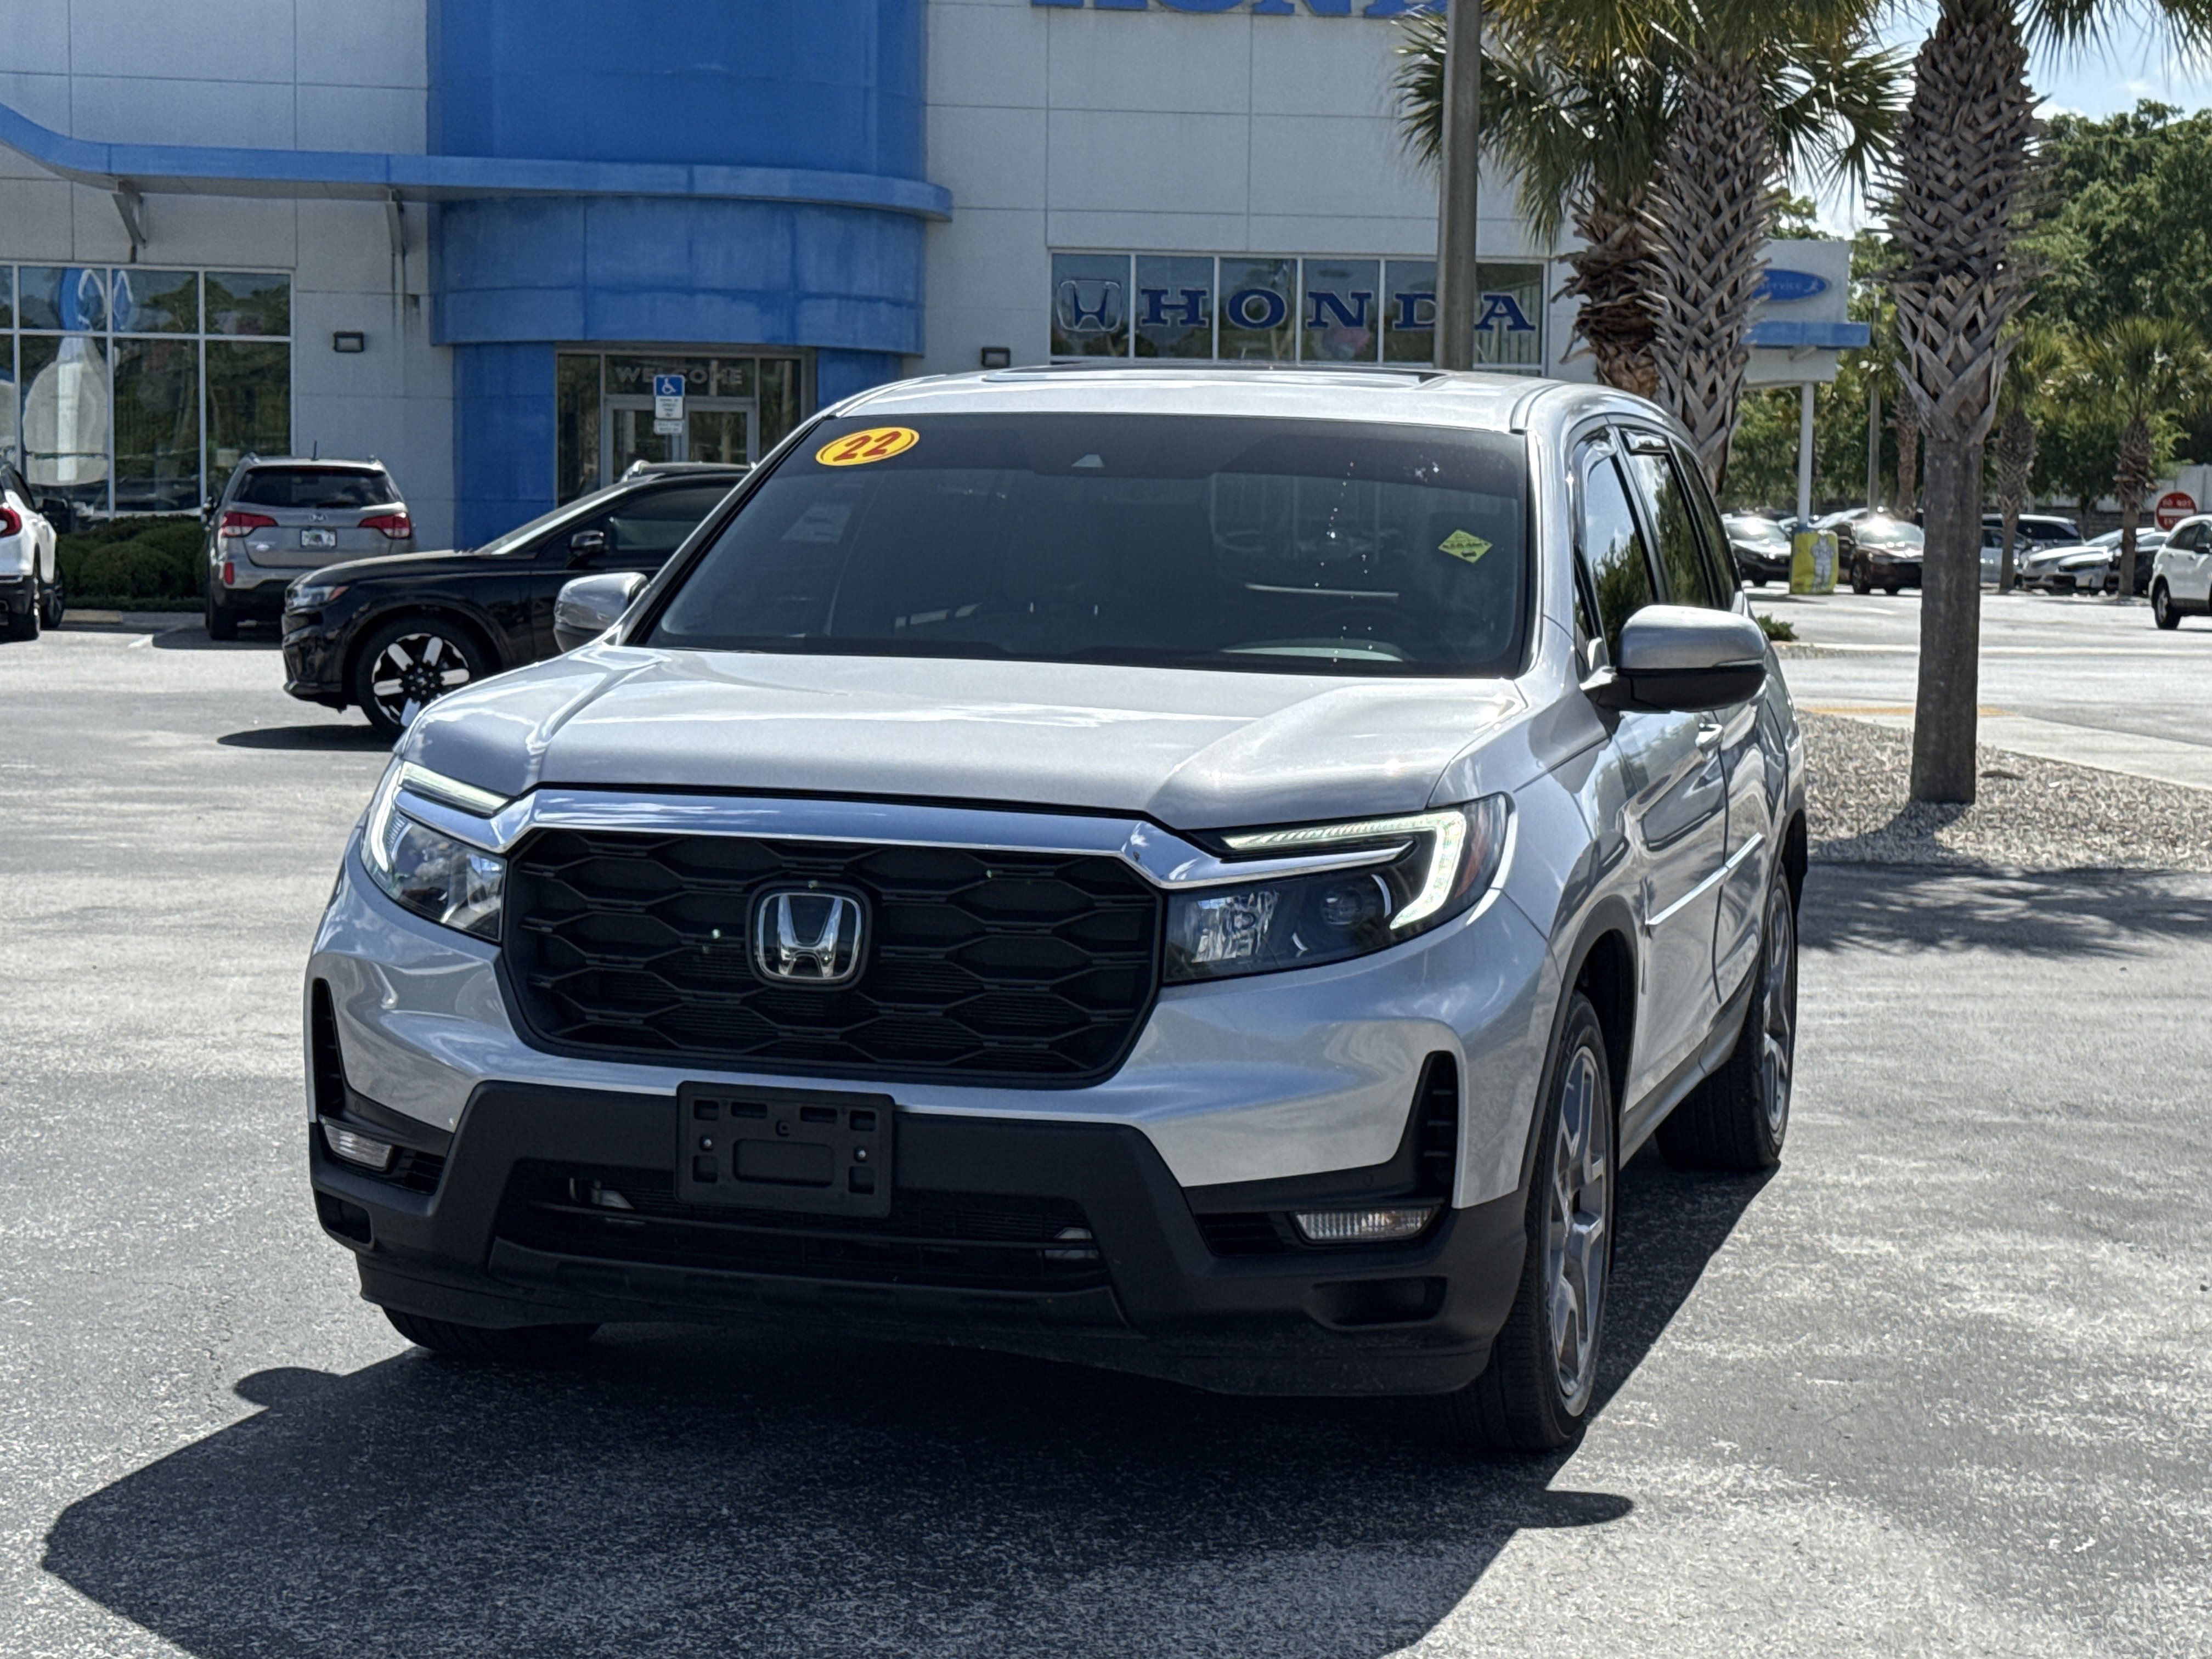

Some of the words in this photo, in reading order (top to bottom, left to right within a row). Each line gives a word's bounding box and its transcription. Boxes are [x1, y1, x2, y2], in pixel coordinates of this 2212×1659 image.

[1140, 287, 1536, 331] HONDA
[615, 366, 742, 385] WECOME
[833, 431, 902, 462] 22
